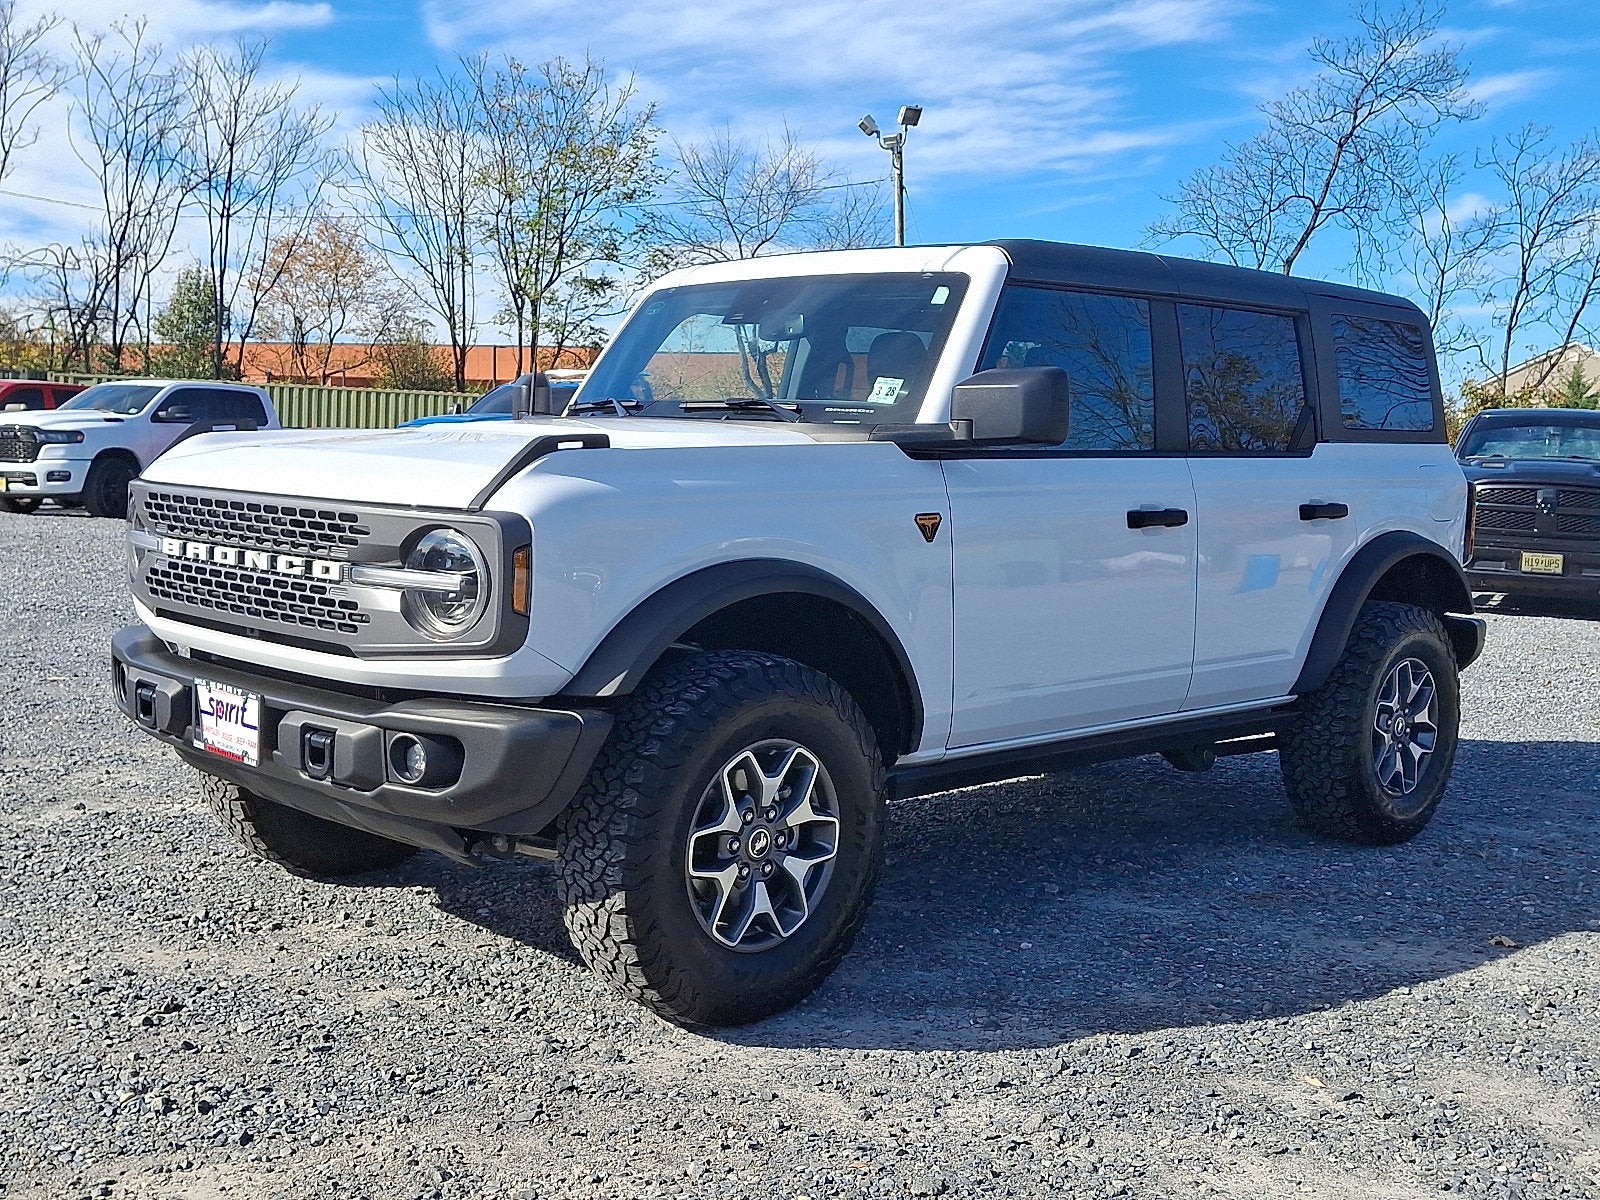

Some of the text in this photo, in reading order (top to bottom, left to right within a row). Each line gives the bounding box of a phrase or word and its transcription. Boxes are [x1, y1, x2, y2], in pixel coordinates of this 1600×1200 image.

[876, 386, 897, 397] 3 28
[162, 537, 343, 583] BRONCO
